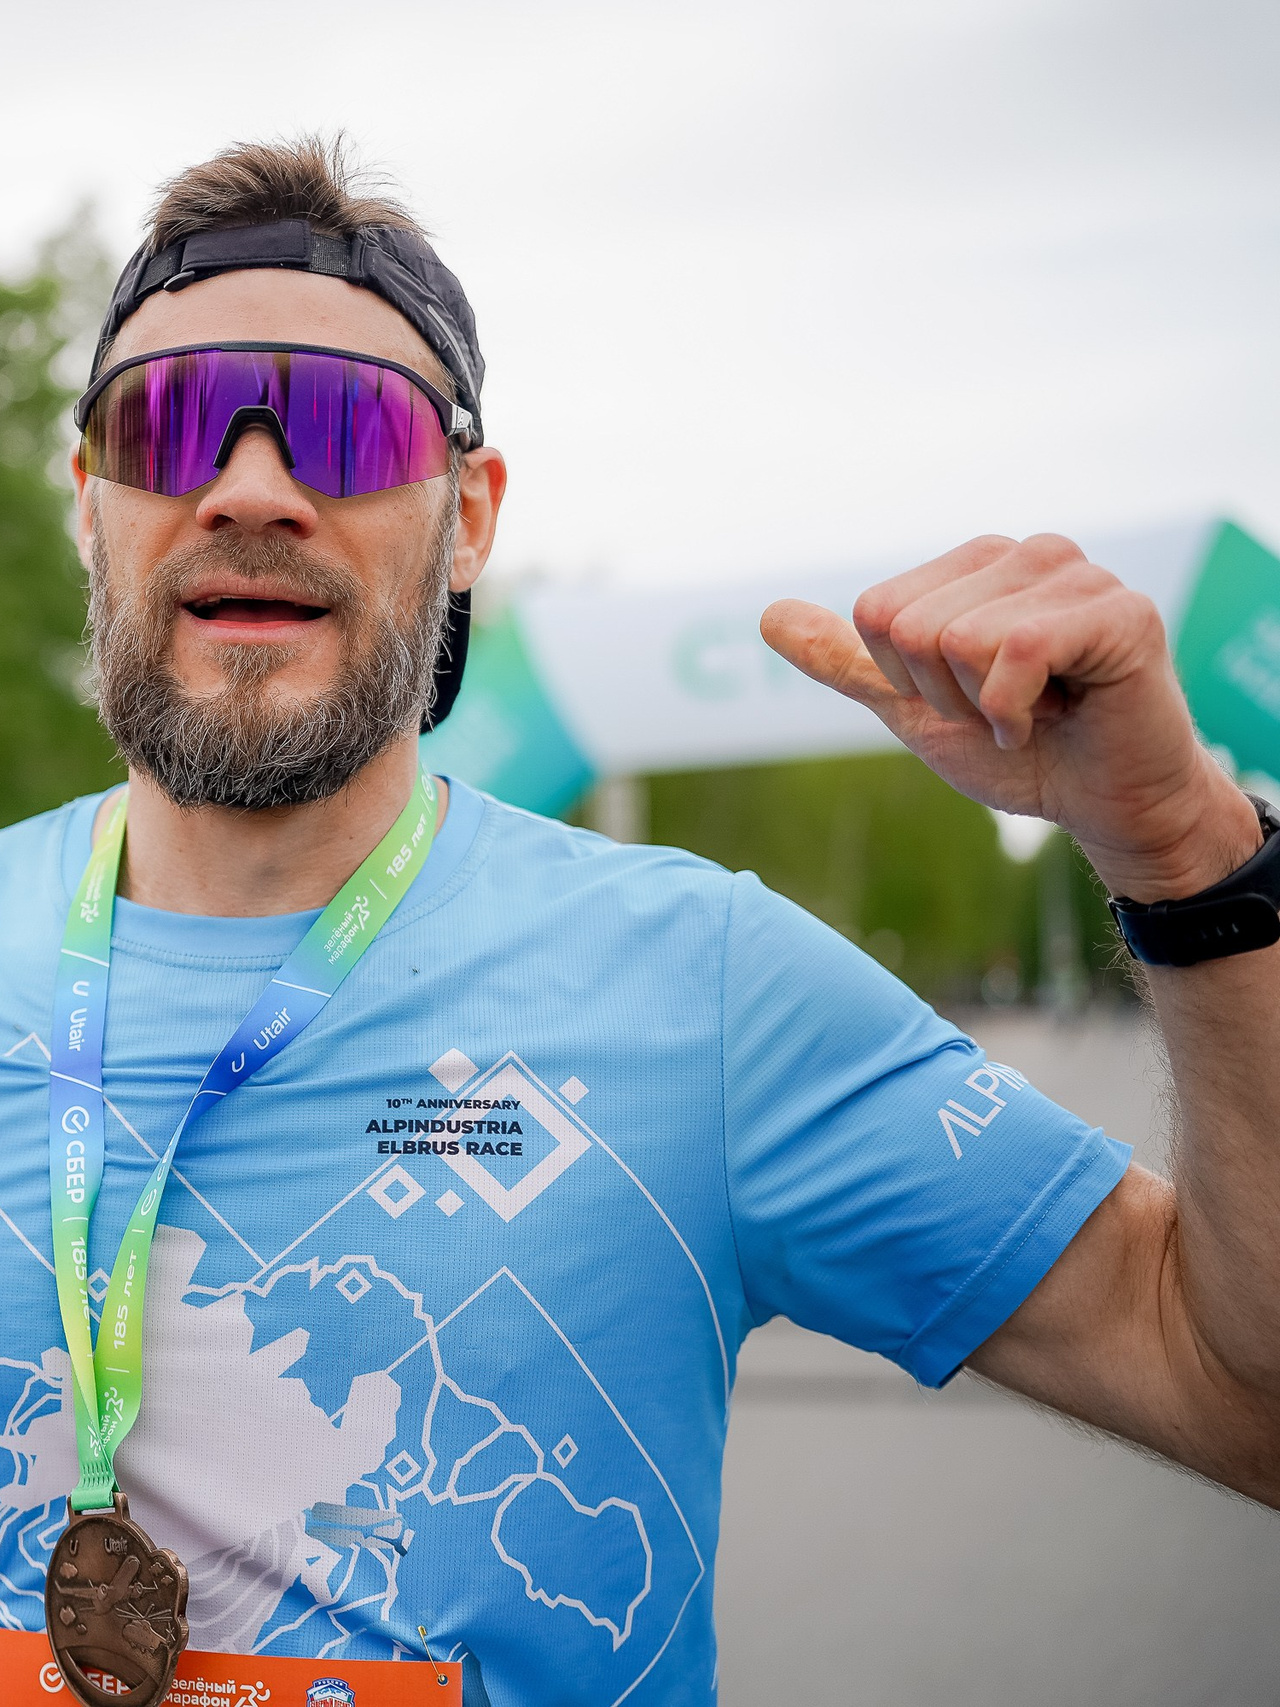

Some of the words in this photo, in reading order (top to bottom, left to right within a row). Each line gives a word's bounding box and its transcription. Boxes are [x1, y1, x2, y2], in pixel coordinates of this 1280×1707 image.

[386, 844, 412, 879] 185
[412, 813, 426, 848] лет
[323, 910, 354, 953] зелёный
[327, 924, 359, 965] марафон
[68, 1007, 88, 1052] Utair
[253, 1007, 291, 1050] Utair
[416, 1098, 521, 1110] ANNIVERSARY
[365, 1119, 523, 1135] ALPINDUSTRIA
[377, 1140, 460, 1156] ELBRUS
[466, 1141, 523, 1157] RACE
[66, 1140, 86, 1204] СБЕР
[71, 1237, 87, 1280] 185
[113, 1305, 128, 1349] 185
[124, 1249, 137, 1297] лет
[171, 1677, 236, 1694] зелёный
